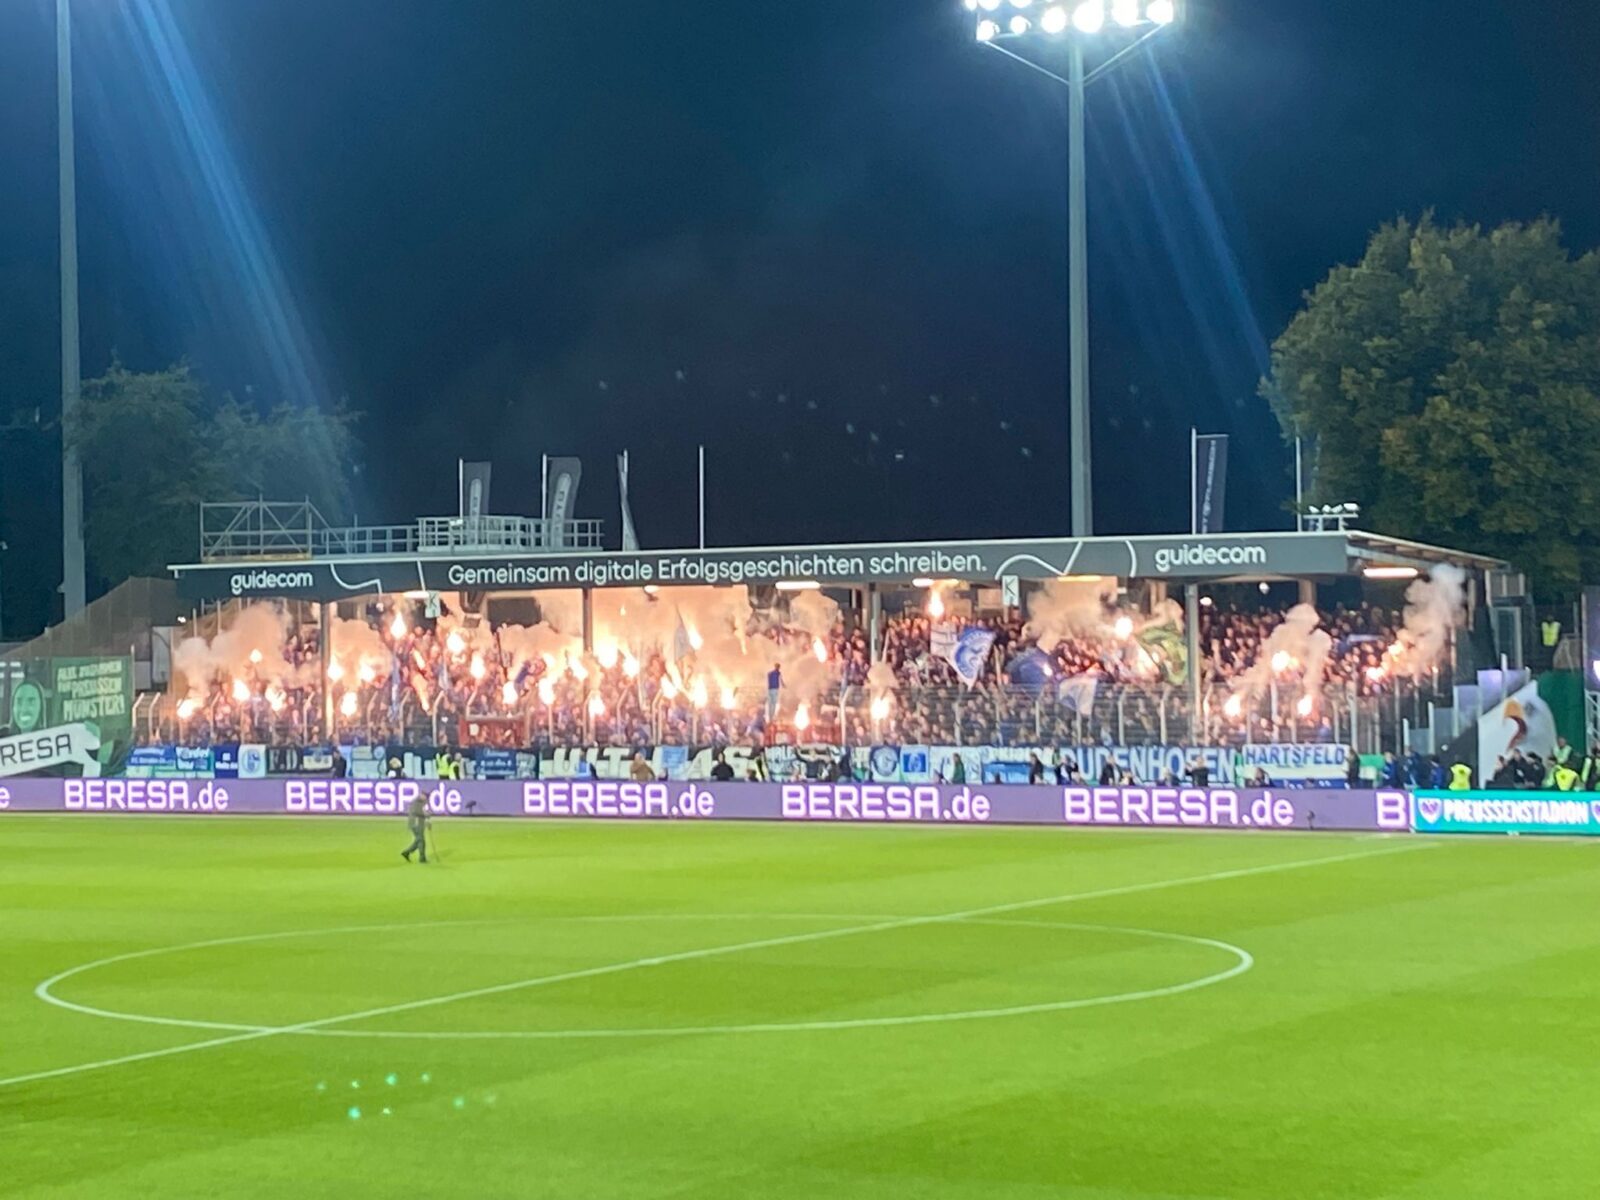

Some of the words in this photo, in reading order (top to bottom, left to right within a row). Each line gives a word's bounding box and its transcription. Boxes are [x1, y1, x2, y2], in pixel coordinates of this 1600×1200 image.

[448, 562, 570, 585] Gemeinsam
[575, 559, 653, 586] digitale
[658, 553, 864, 584] Erfolgsgeschichten
[870, 550, 988, 574] schreiben.
[1155, 543, 1267, 573] guidecom
[230, 569, 314, 596] guidecom
[64, 780, 229, 810] BERESA.de
[523, 782, 714, 816] BERESA.de
[782, 785, 991, 820] BERESA.de
[1064, 787, 1294, 826] BERESA.de
